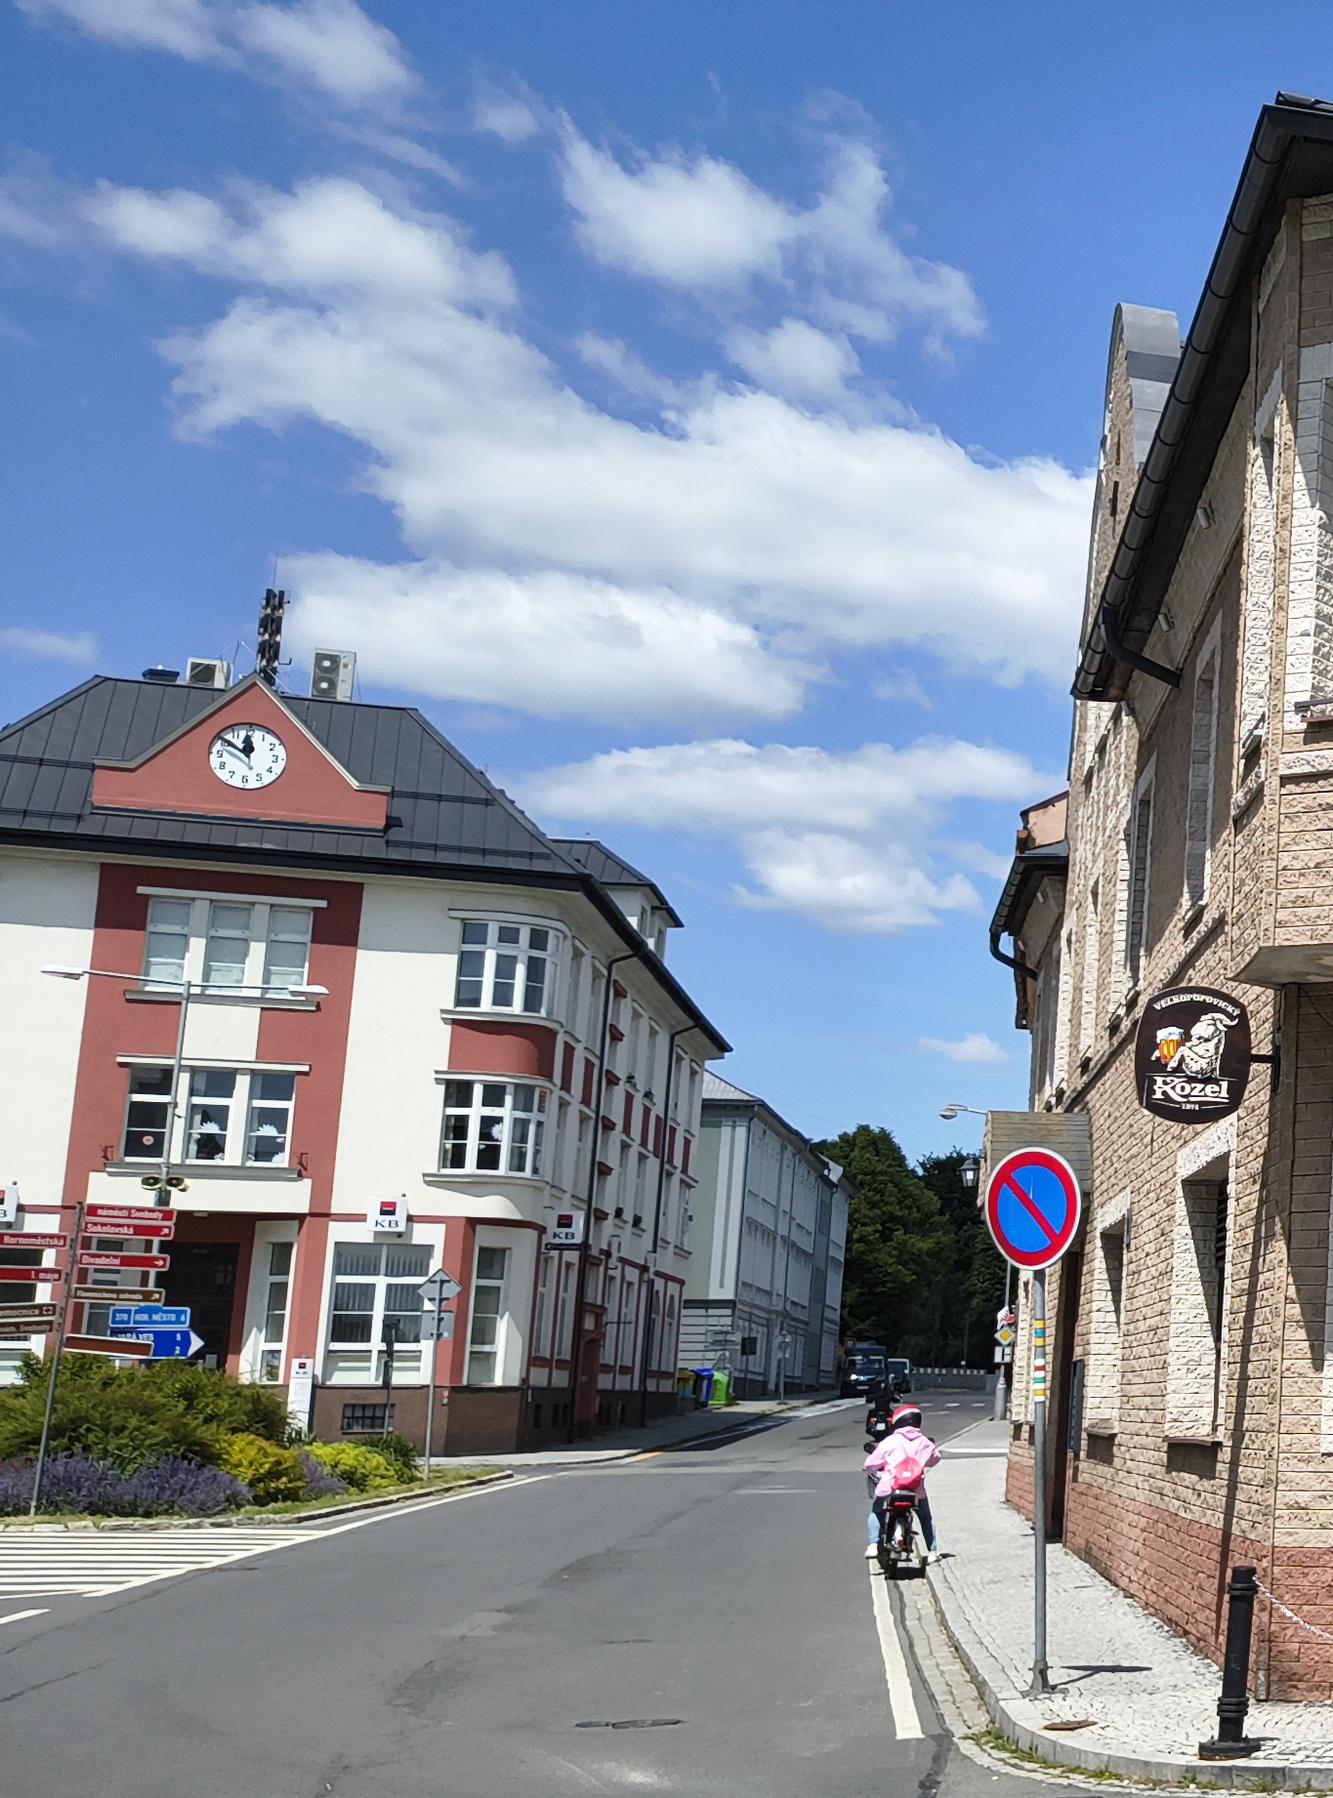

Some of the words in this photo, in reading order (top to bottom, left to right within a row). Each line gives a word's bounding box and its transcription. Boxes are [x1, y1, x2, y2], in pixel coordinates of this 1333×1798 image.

[1152, 1076, 1230, 1102] Kozel
[374, 1219, 399, 1228] KB
[553, 1231, 576, 1240] KB
